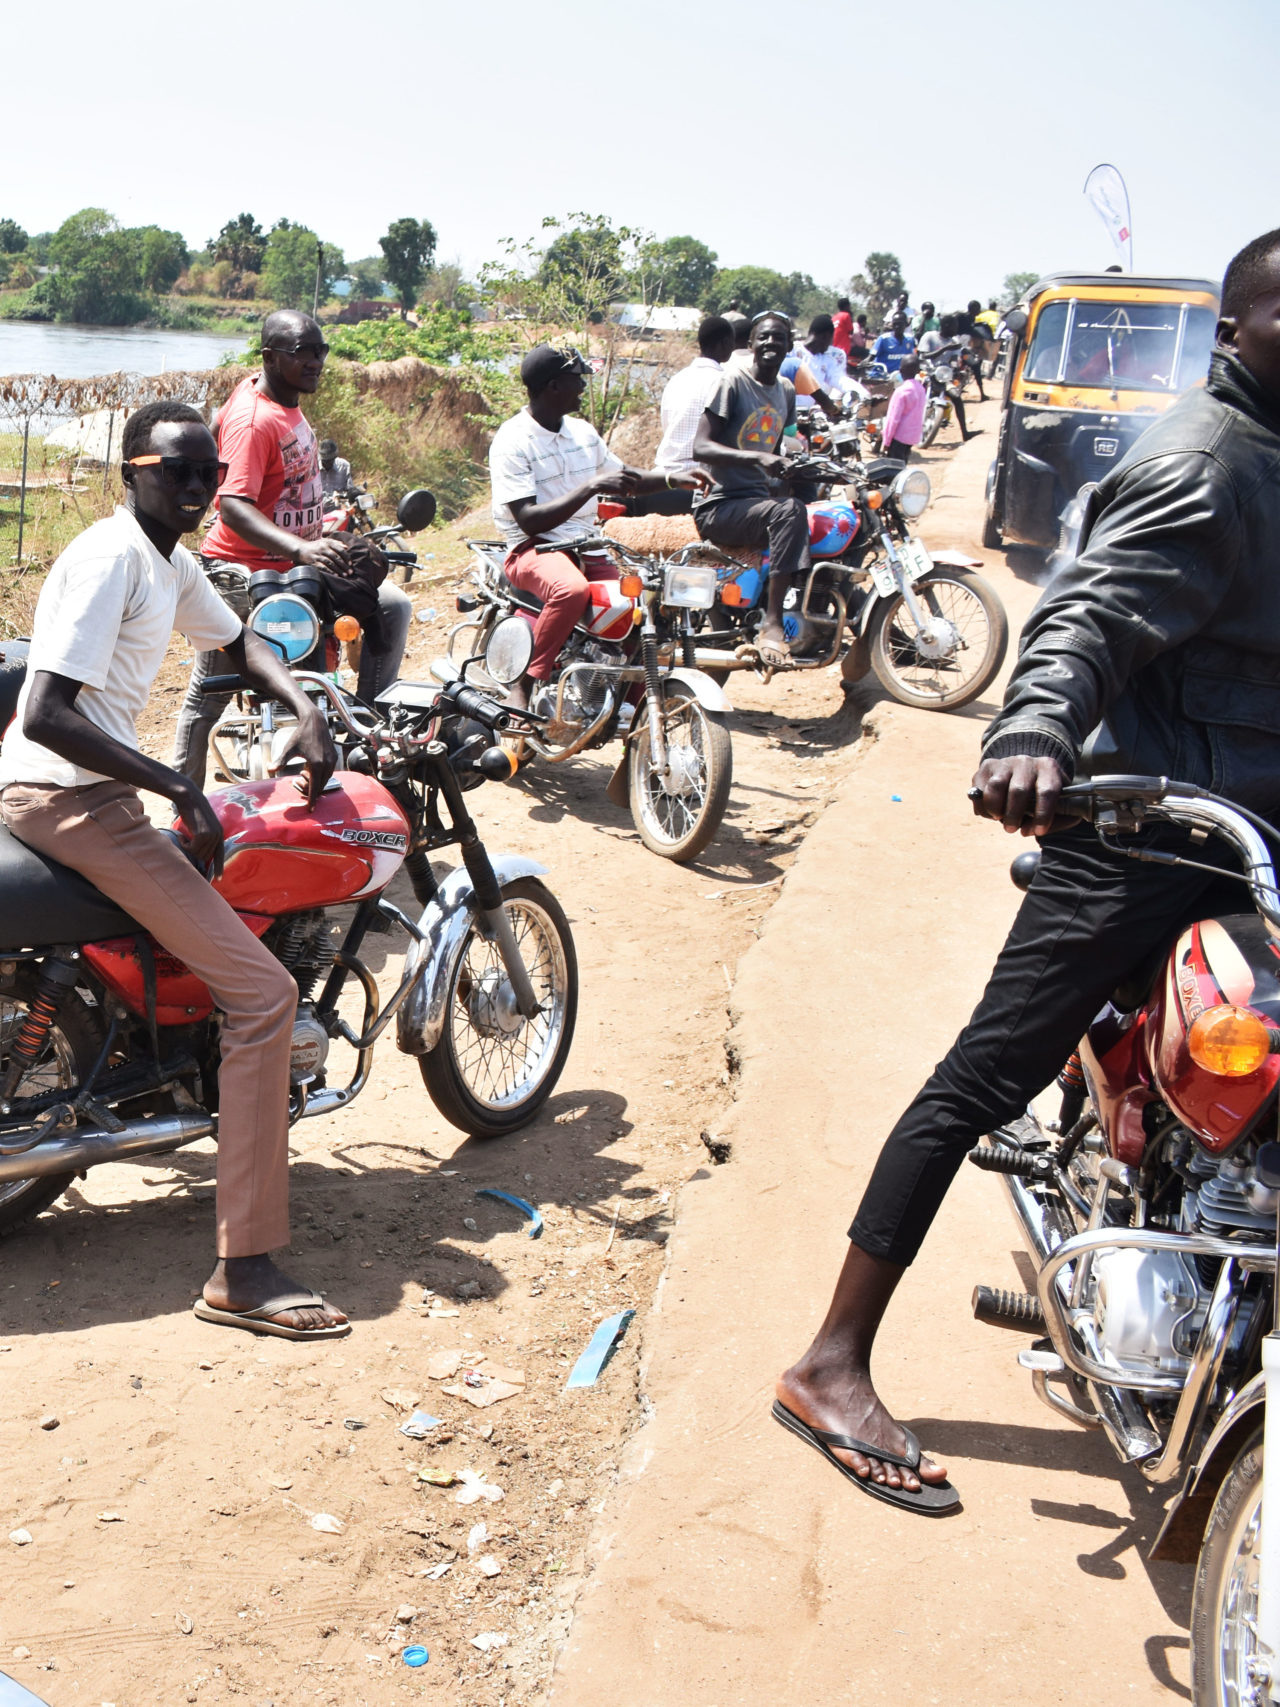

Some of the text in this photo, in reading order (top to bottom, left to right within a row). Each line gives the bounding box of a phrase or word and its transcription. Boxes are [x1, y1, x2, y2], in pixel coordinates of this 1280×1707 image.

[1097, 443, 1115, 453] RE
[273, 505, 322, 527] LONDO
[340, 828, 407, 847] BOXER
[1178, 963, 1205, 1022] BOXE
